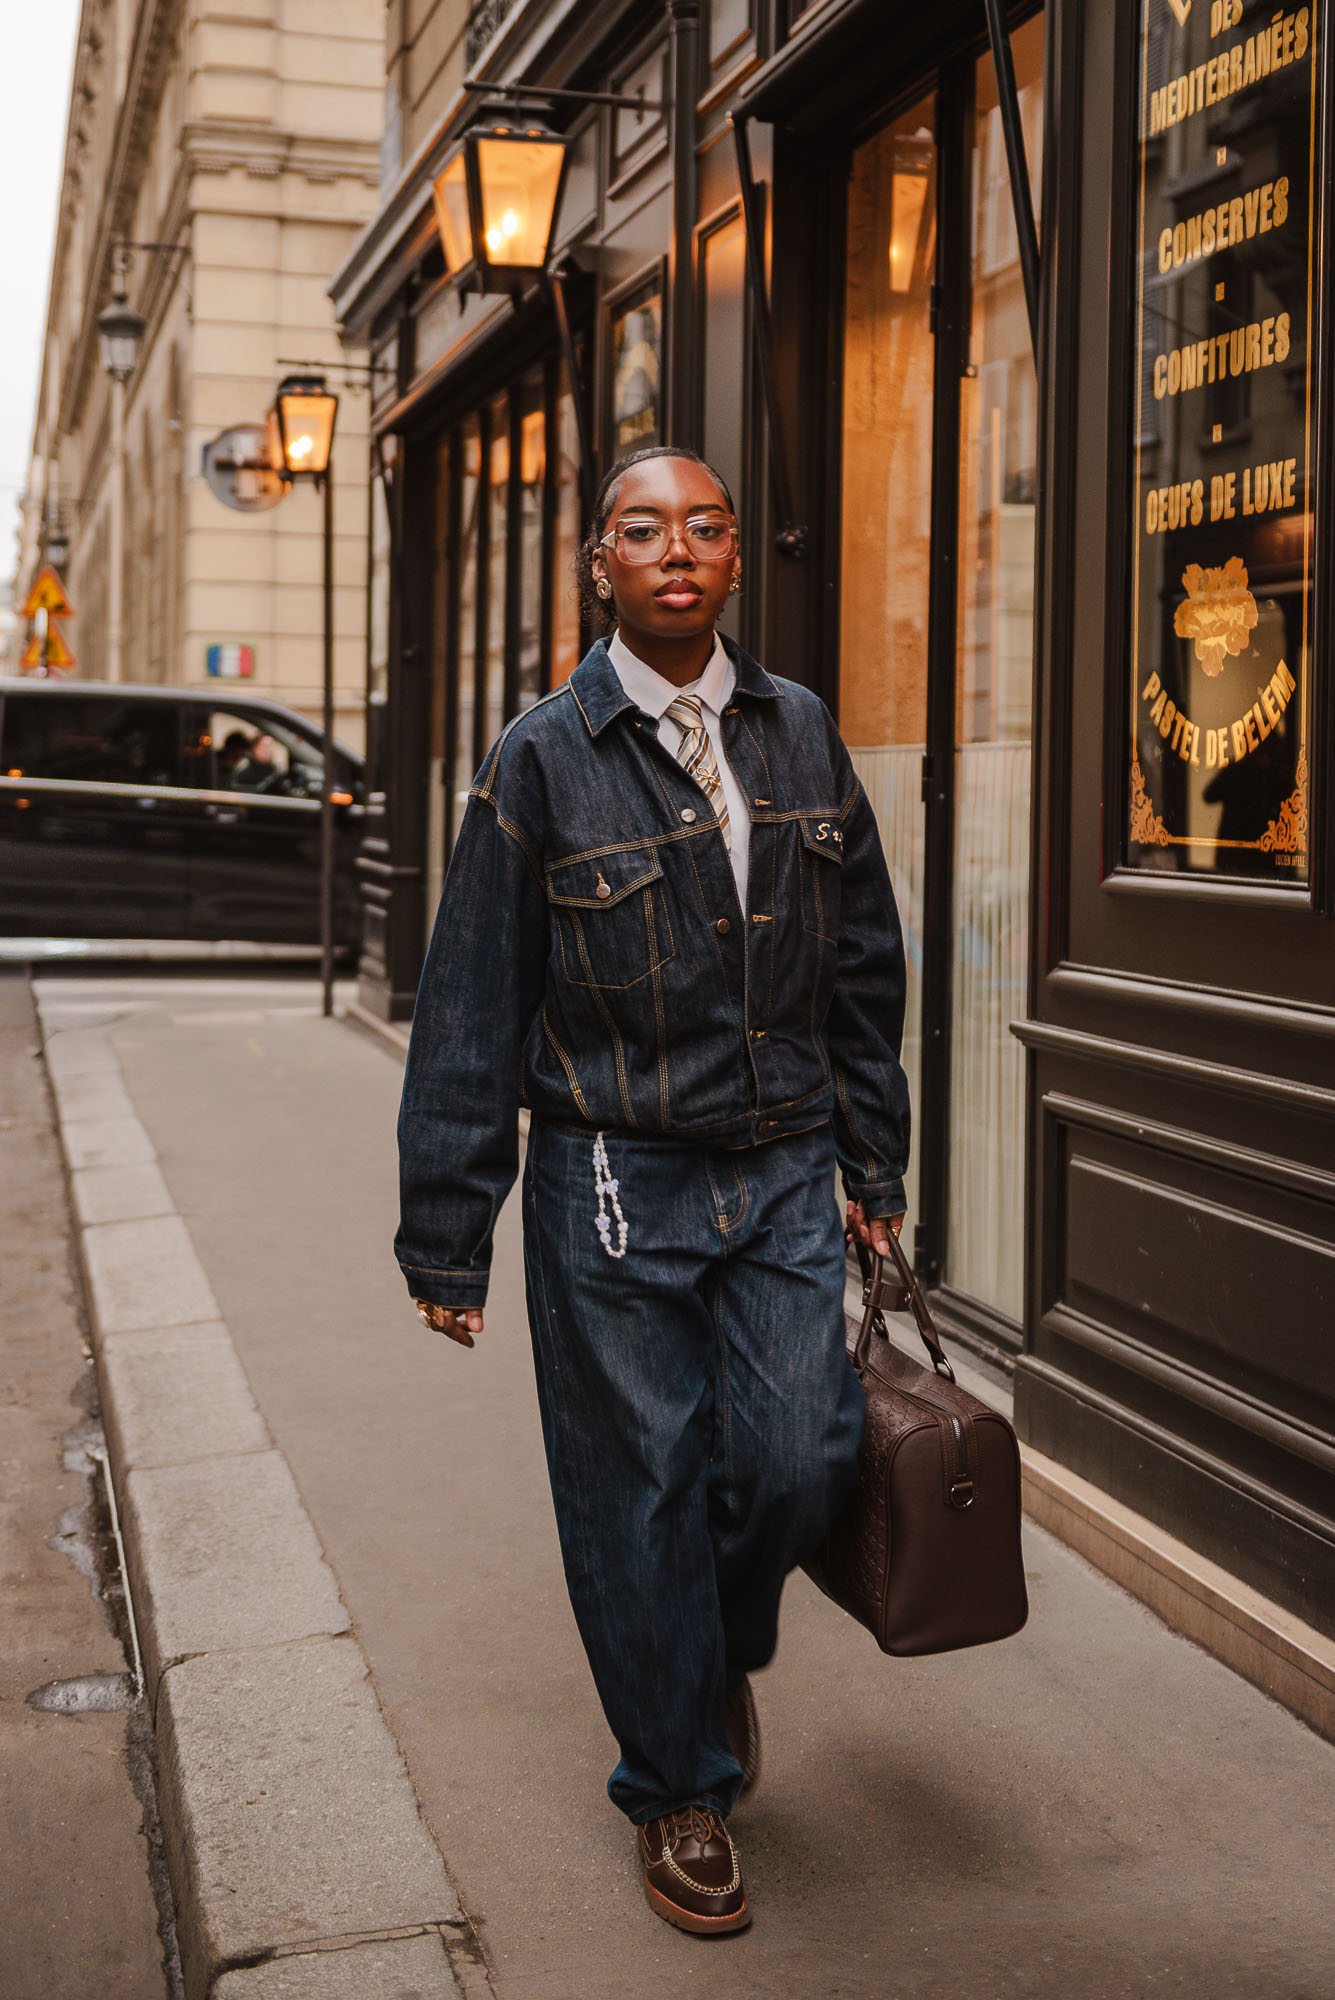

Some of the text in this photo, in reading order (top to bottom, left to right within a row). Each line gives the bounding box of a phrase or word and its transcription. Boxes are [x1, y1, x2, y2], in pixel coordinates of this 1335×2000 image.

[1149, 6, 1309, 137] MEDITERRANÉES
[1158, 176, 1289, 274] CONSERVES
[1153, 312, 1290, 400] CONFITURES
[1145, 458, 1296, 535] OEUFS DE LUXE
[1142, 658, 1296, 769] PASTEL DE BELEM
